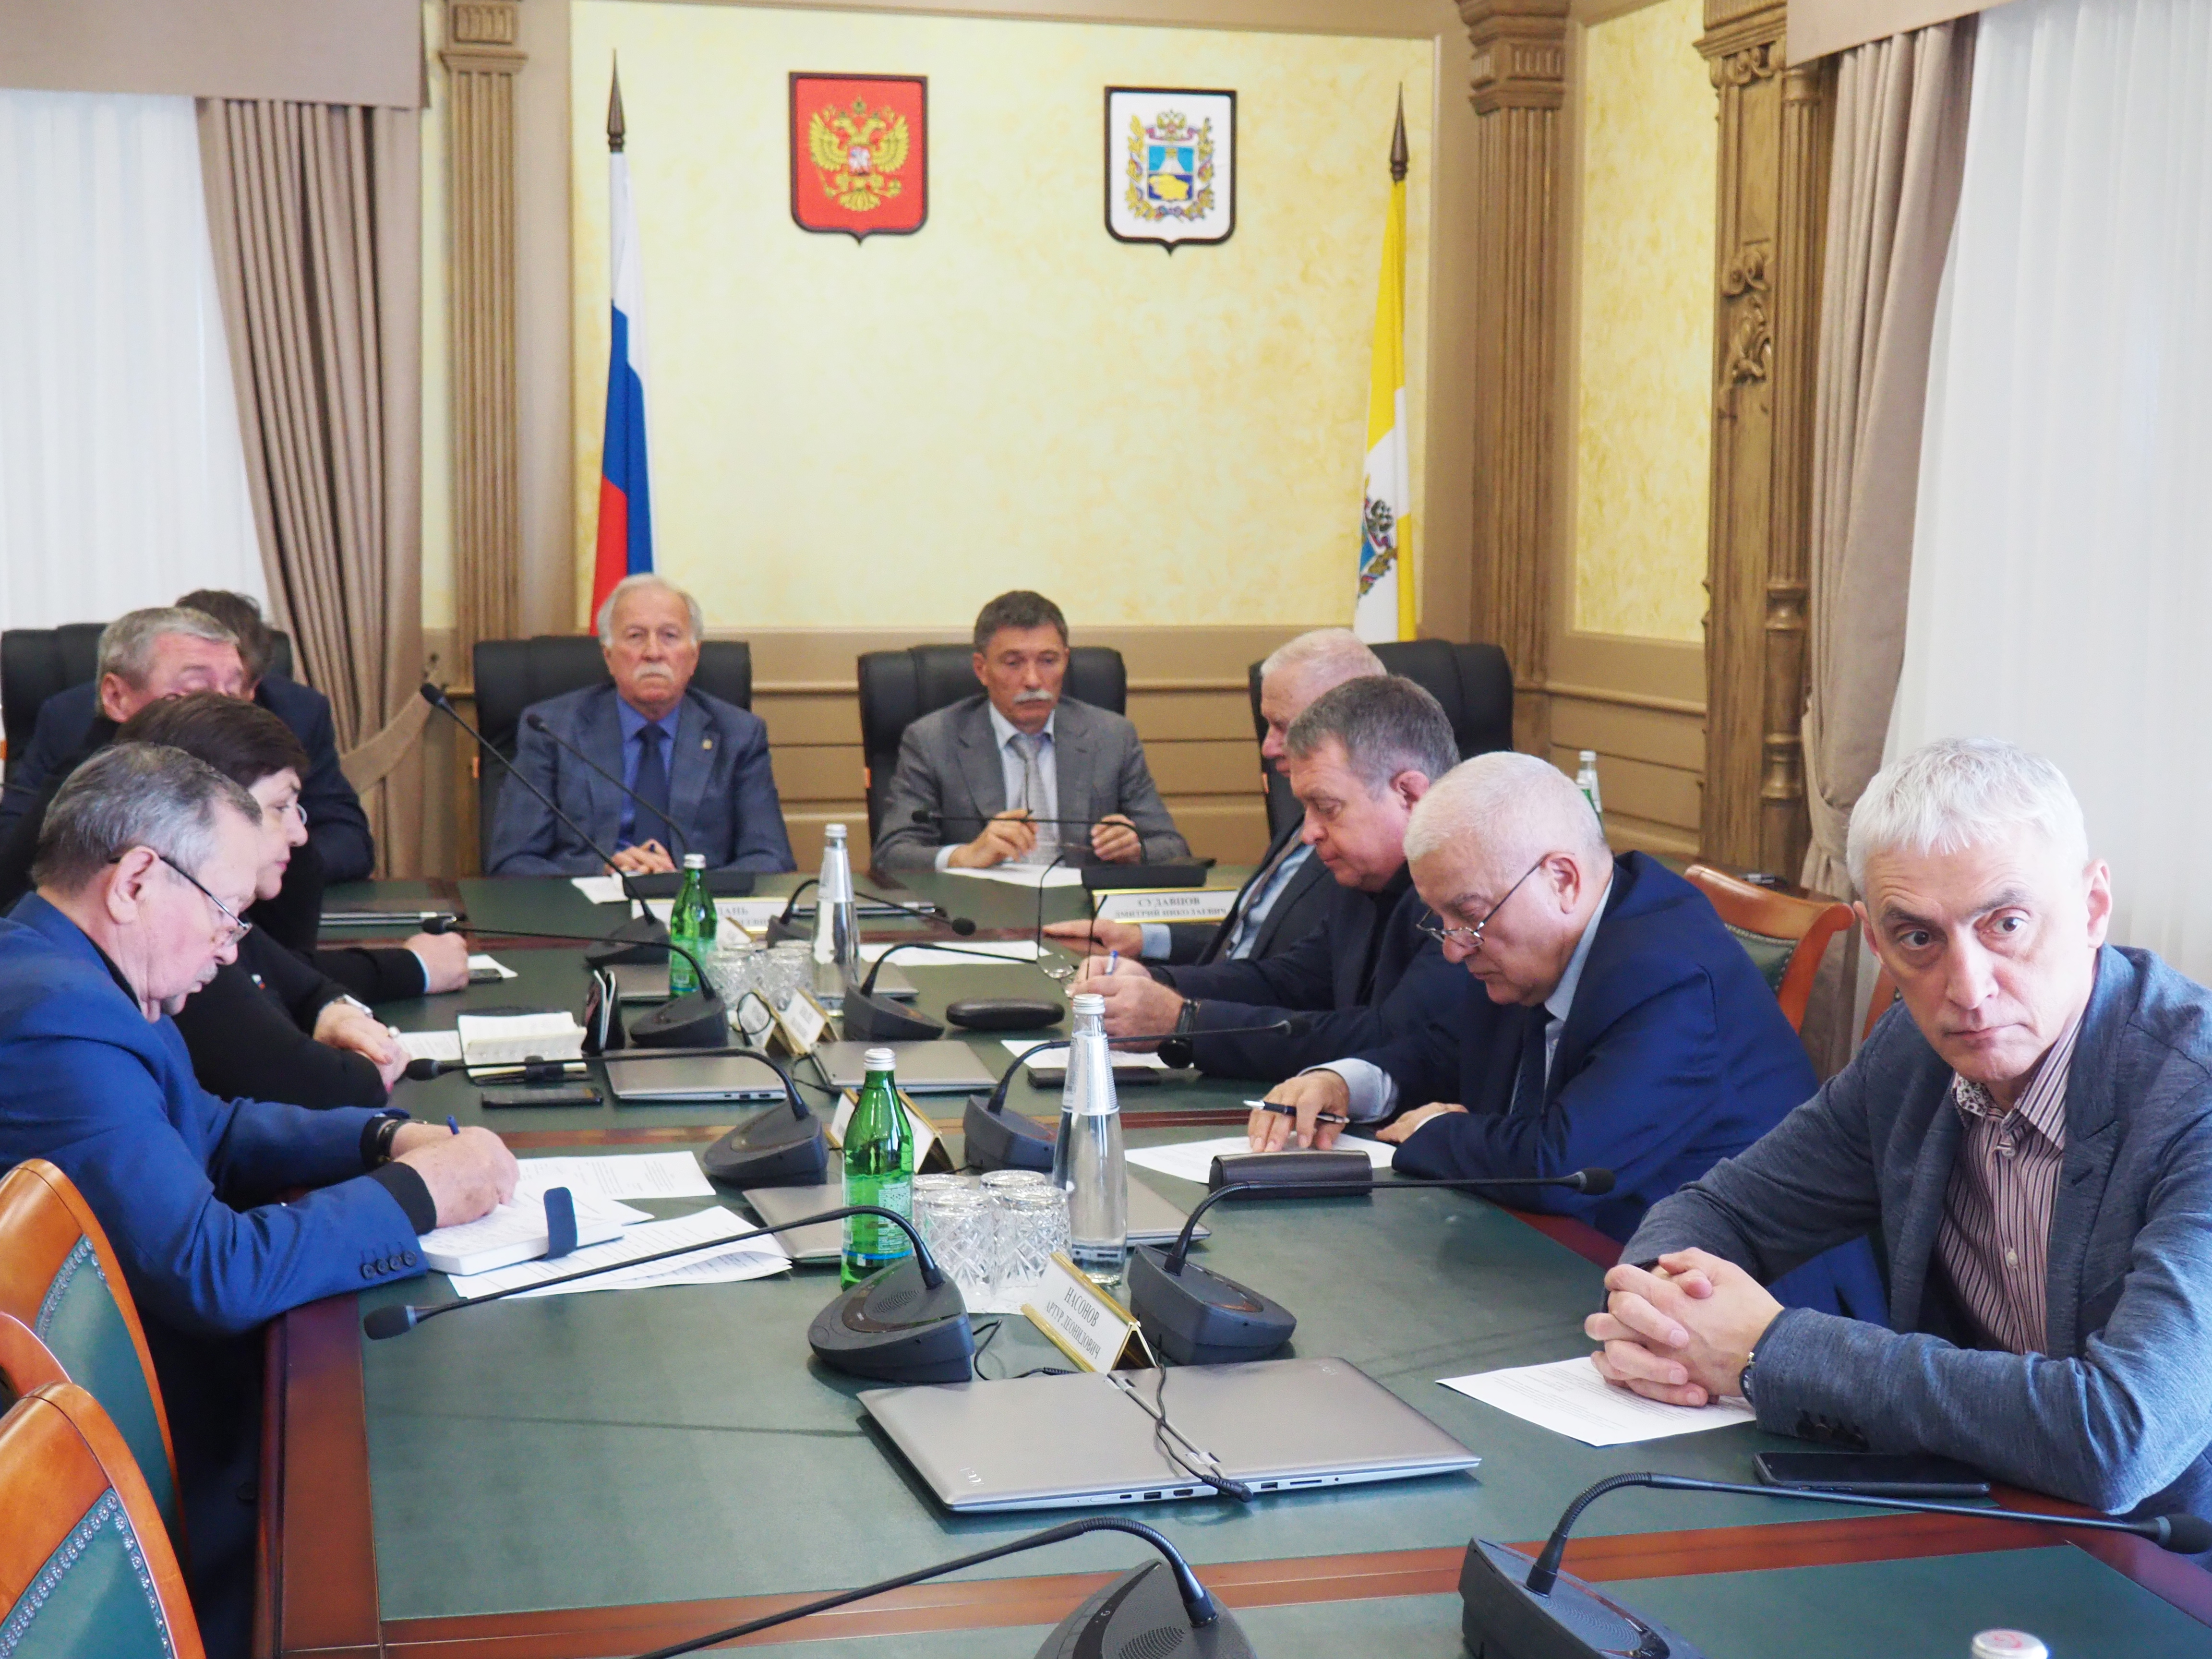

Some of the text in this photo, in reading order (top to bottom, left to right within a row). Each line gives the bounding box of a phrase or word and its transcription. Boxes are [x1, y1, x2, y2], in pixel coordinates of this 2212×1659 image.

[1046, 1300, 1101, 1359] АРТУР ЛЕОНИДОВИЧ
[1064, 1286, 1100, 1327] НАСОНОВ
